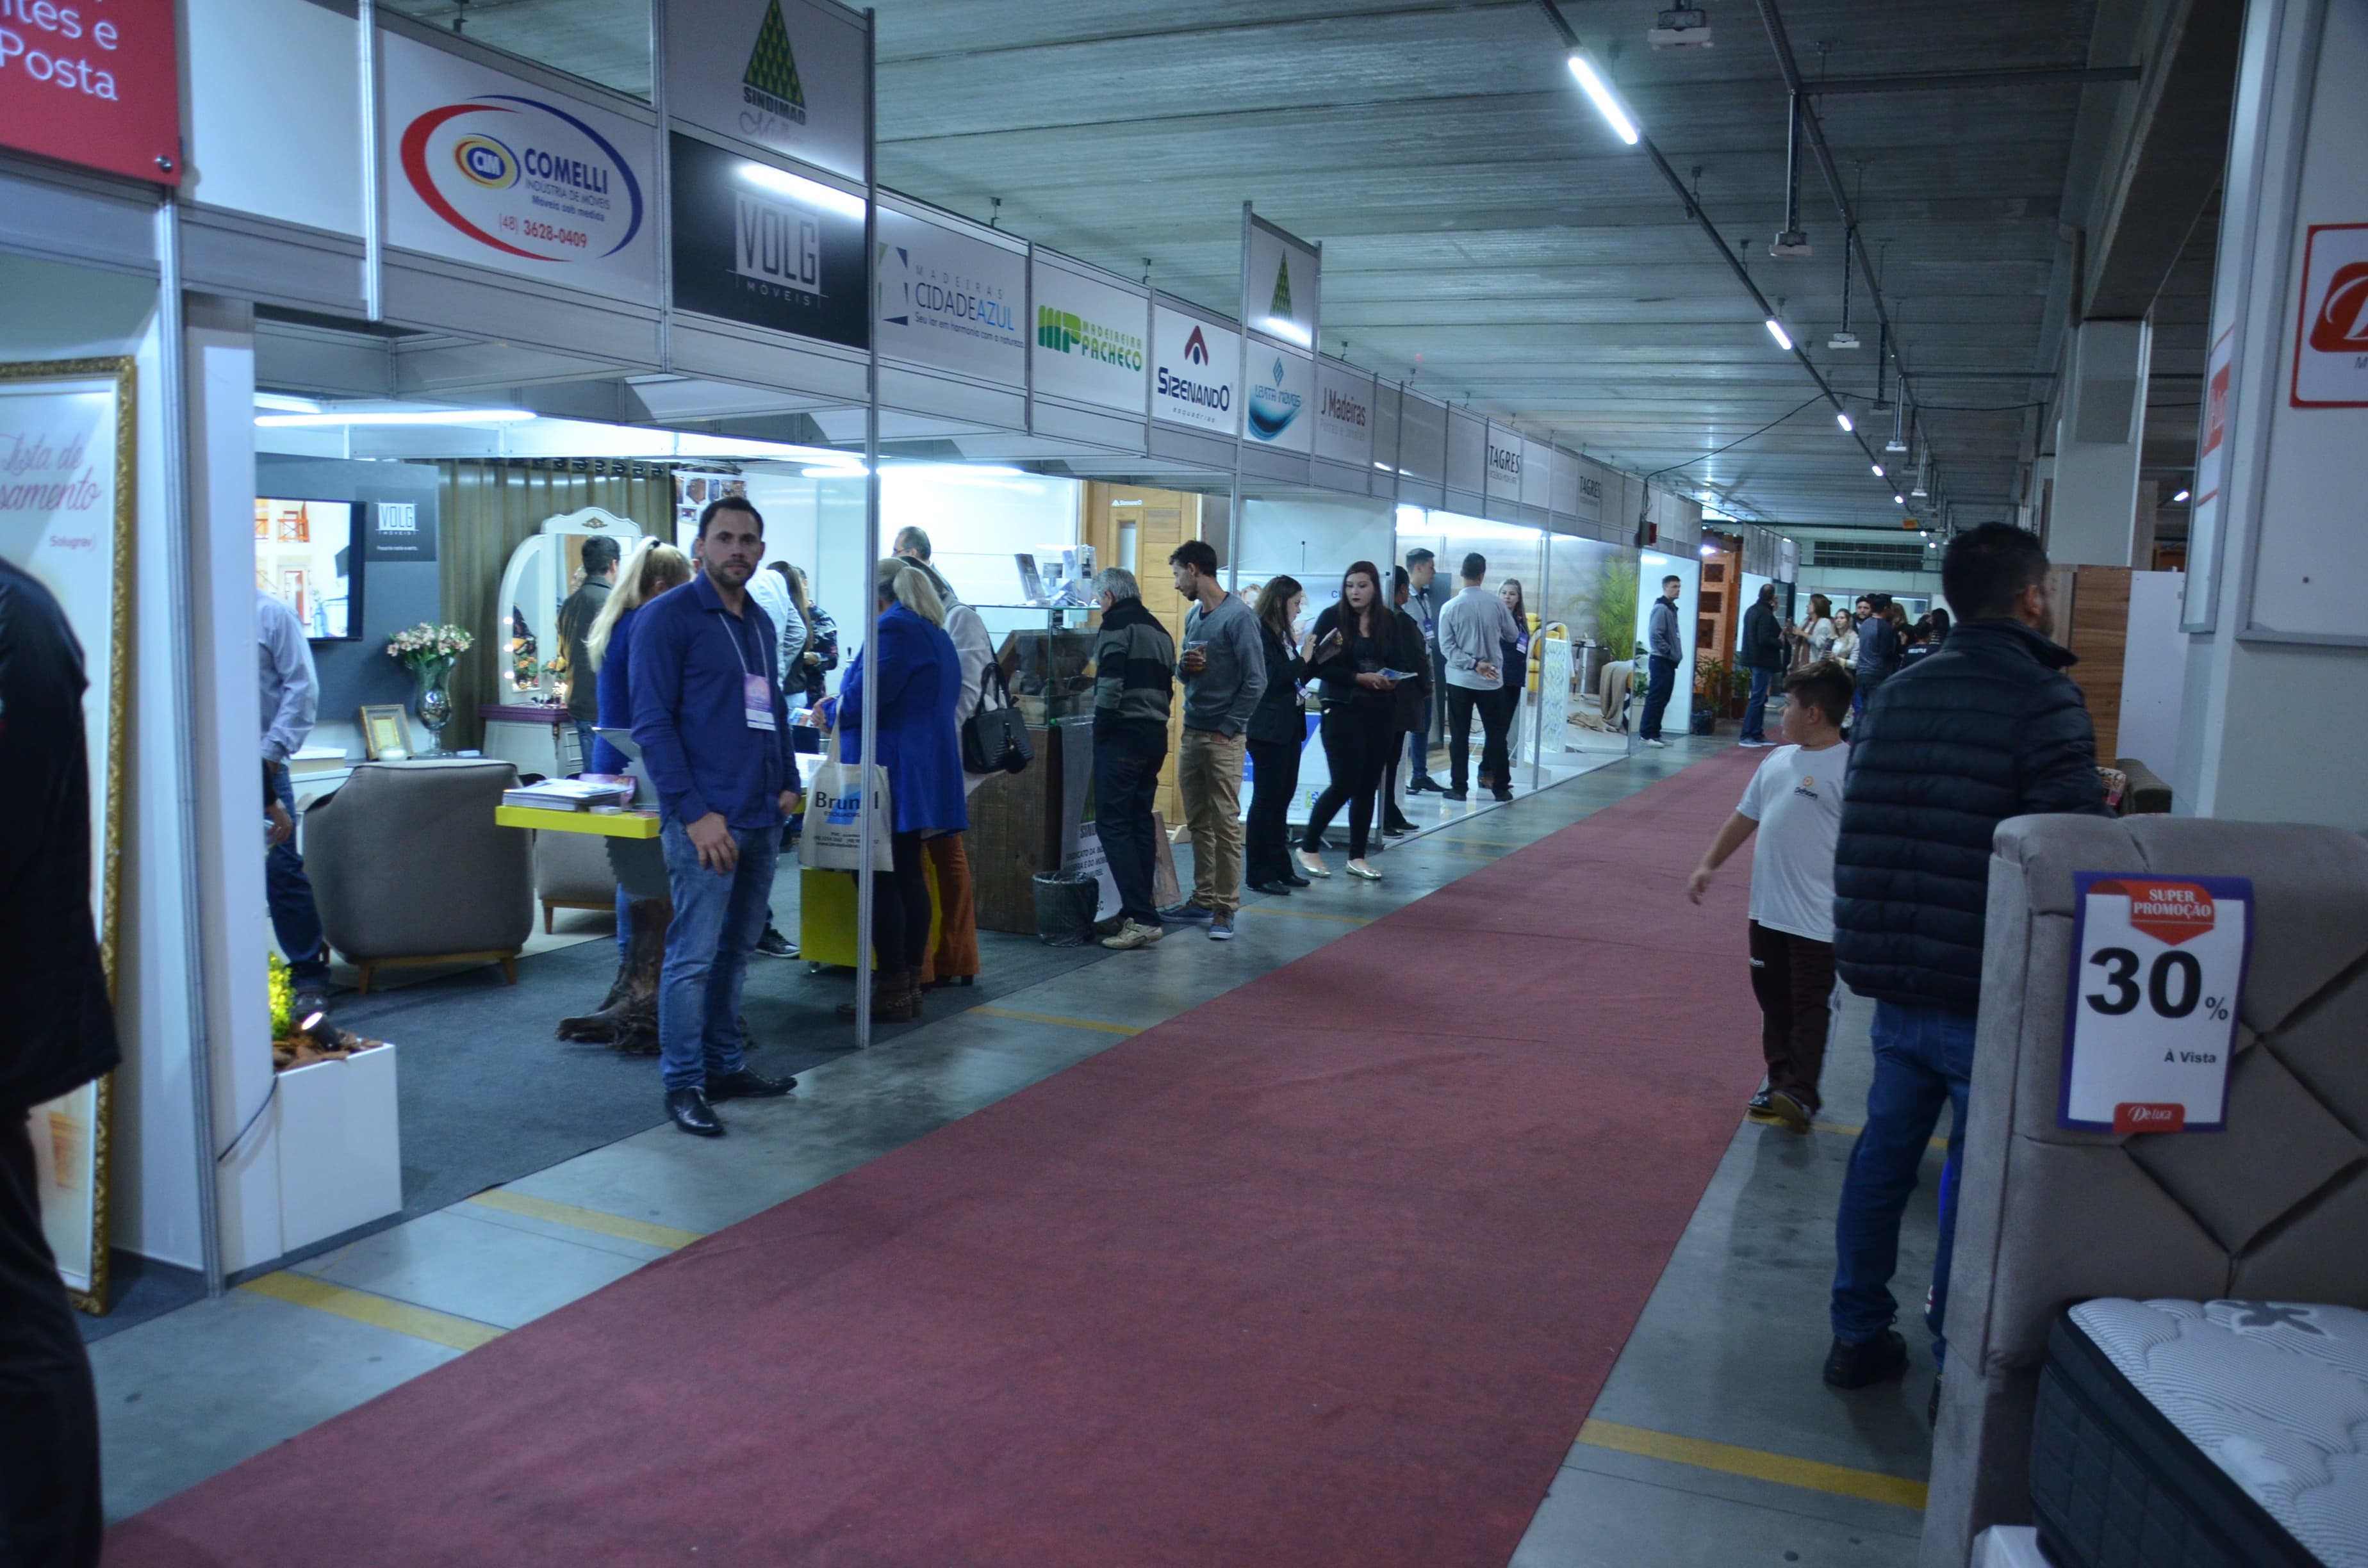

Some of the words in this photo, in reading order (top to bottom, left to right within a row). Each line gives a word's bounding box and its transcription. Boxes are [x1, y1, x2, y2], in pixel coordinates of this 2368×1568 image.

[94, 21, 118, 51] e
[0, 28, 119, 101] Posta
[523, 147, 608, 195] COMELLI
[499, 213, 518, 235] (48)
[523, 219, 588, 249] 3628-0409
[741, 200, 817, 286] VOLG
[916, 264, 1003, 300] MADEIRAS
[1158, 366, 1231, 412] SIZENANDO
[1320, 386, 1328, 416] J
[1328, 389, 1367, 427] Madeiras
[1488, 445, 1521, 475] TAGRES
[1579, 475, 1602, 499] TAGRES
[380, 506, 413, 528] VOLG
[815, 790, 879, 811] Brunl
[2133, 901, 2212, 919] PROMOÇÃO
[2148, 888, 2195, 903] SUPER
[2180, 1051, 2217, 1063] Vista
